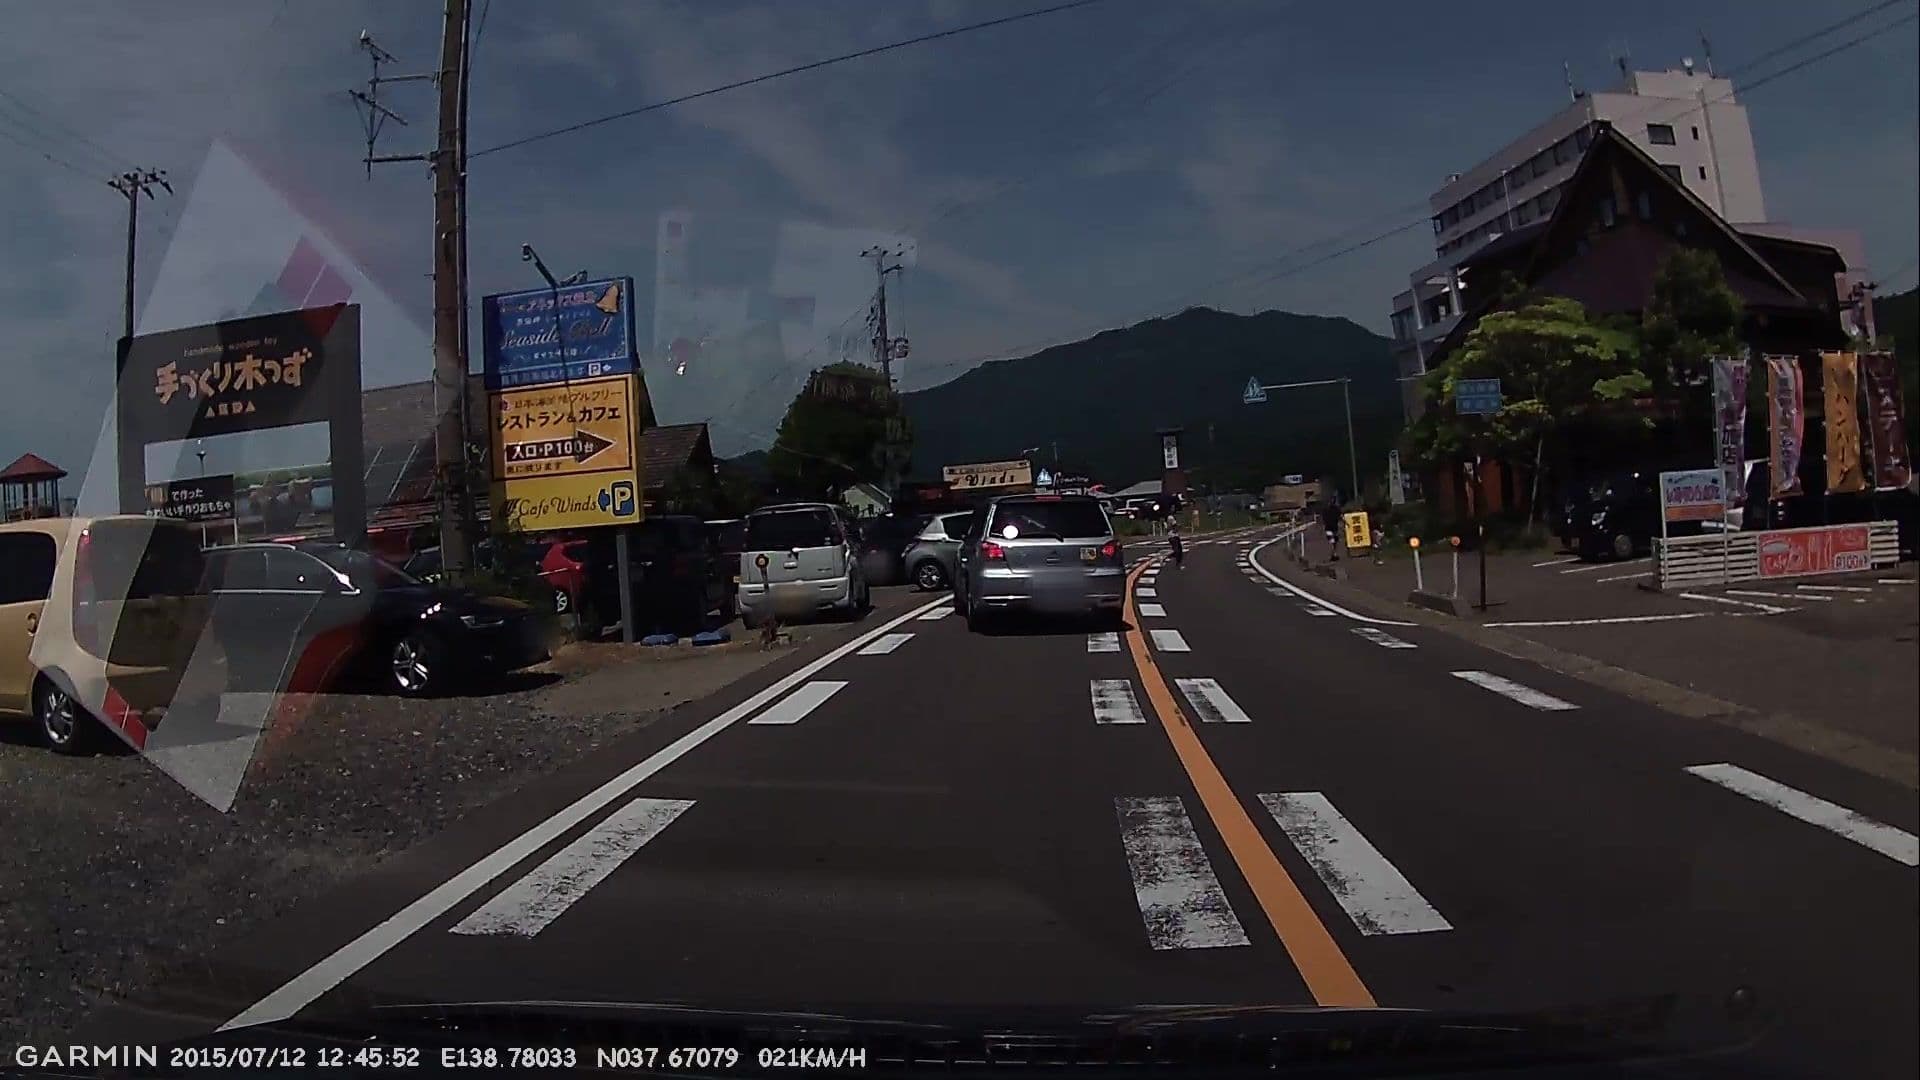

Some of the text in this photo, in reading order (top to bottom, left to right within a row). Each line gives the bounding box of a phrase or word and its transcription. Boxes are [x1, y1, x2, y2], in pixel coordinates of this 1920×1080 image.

[500, 323, 560, 351] Seaside
[589, 364, 600, 376] P
[551, 495, 597, 513] Winds
[615, 487, 631, 511] P
